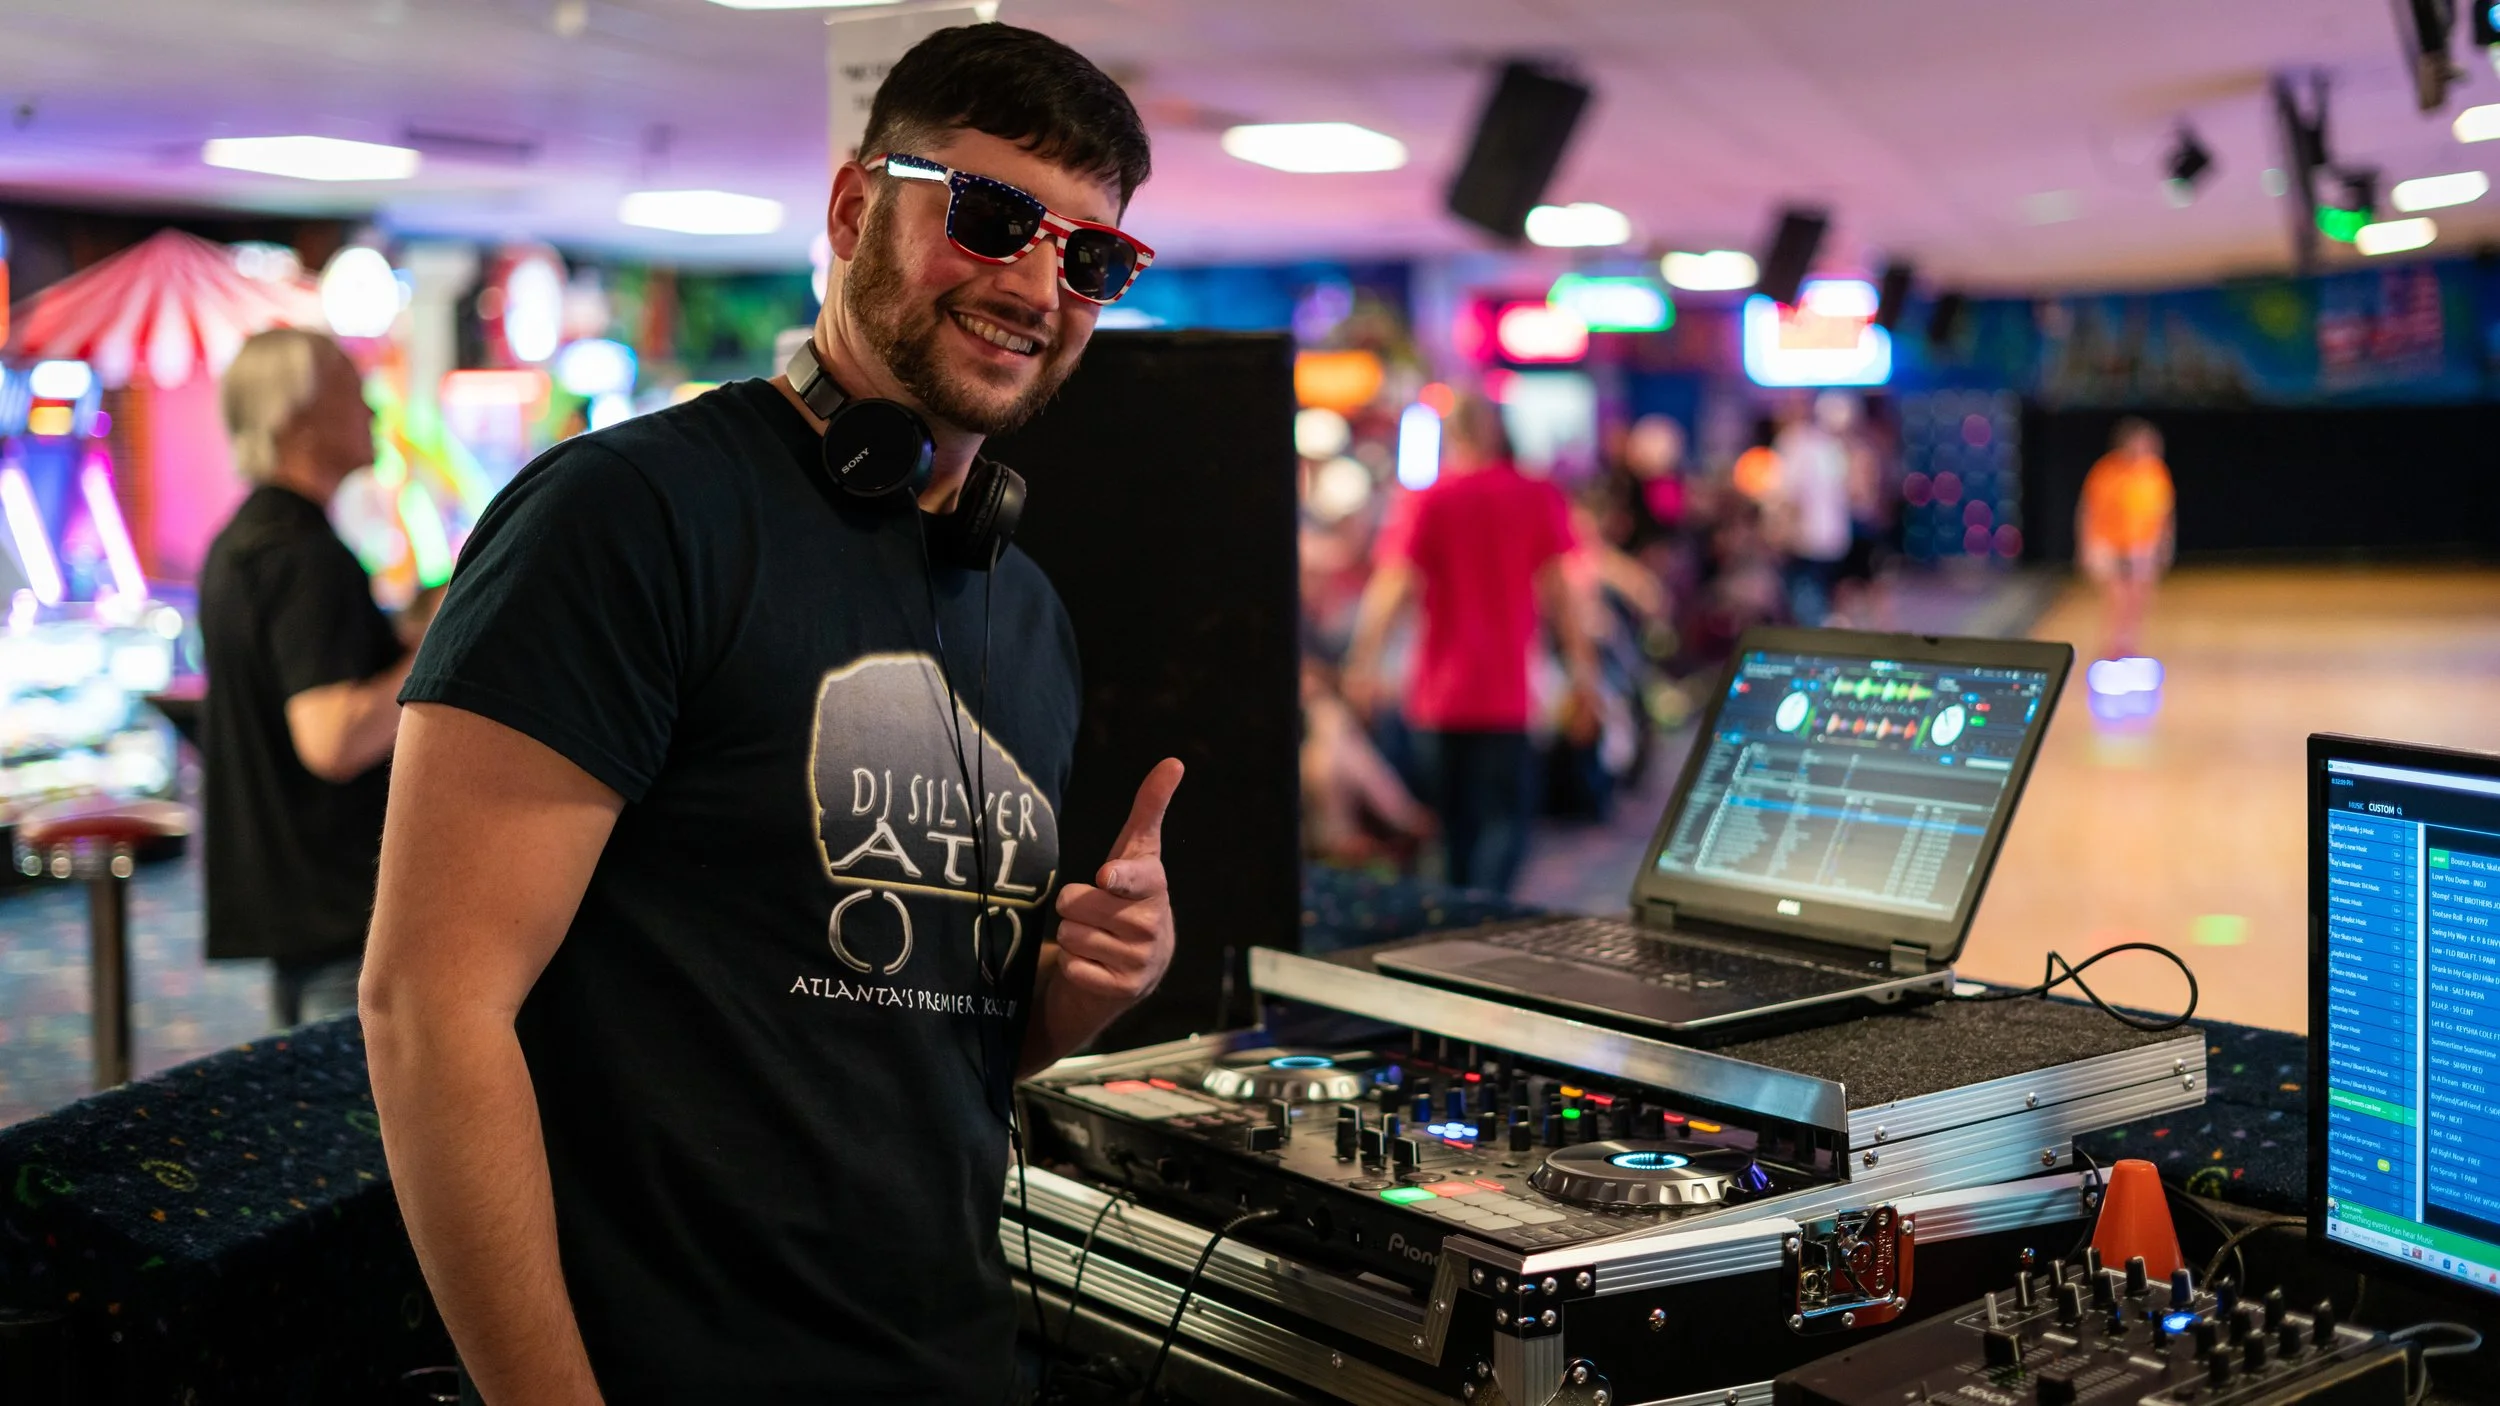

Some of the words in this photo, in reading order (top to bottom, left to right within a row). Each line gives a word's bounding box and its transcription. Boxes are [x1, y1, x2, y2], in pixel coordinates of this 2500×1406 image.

[841, 447, 870, 475] SONY
[852, 767, 893, 824] DJ
[908, 774, 1038, 840] SILVER
[2349, 801, 2364, 810] MUSIC
[2369, 803, 2394, 814] CUSTOM
[830, 820, 1037, 895] ATL
[2432, 872, 2444, 881] Love
[2445, 874, 2454, 883] You
[790, 975, 914, 1008] ATLANTA'S
[917, 990, 976, 1015] PREMIER
[2342, 1211, 2371, 1227] something
[2372, 1221, 2390, 1232] events
[2392, 1227, 2401, 1235] can
[2403, 1230, 2416, 1239] hear
[2417, 1233, 2433, 1246] Music
